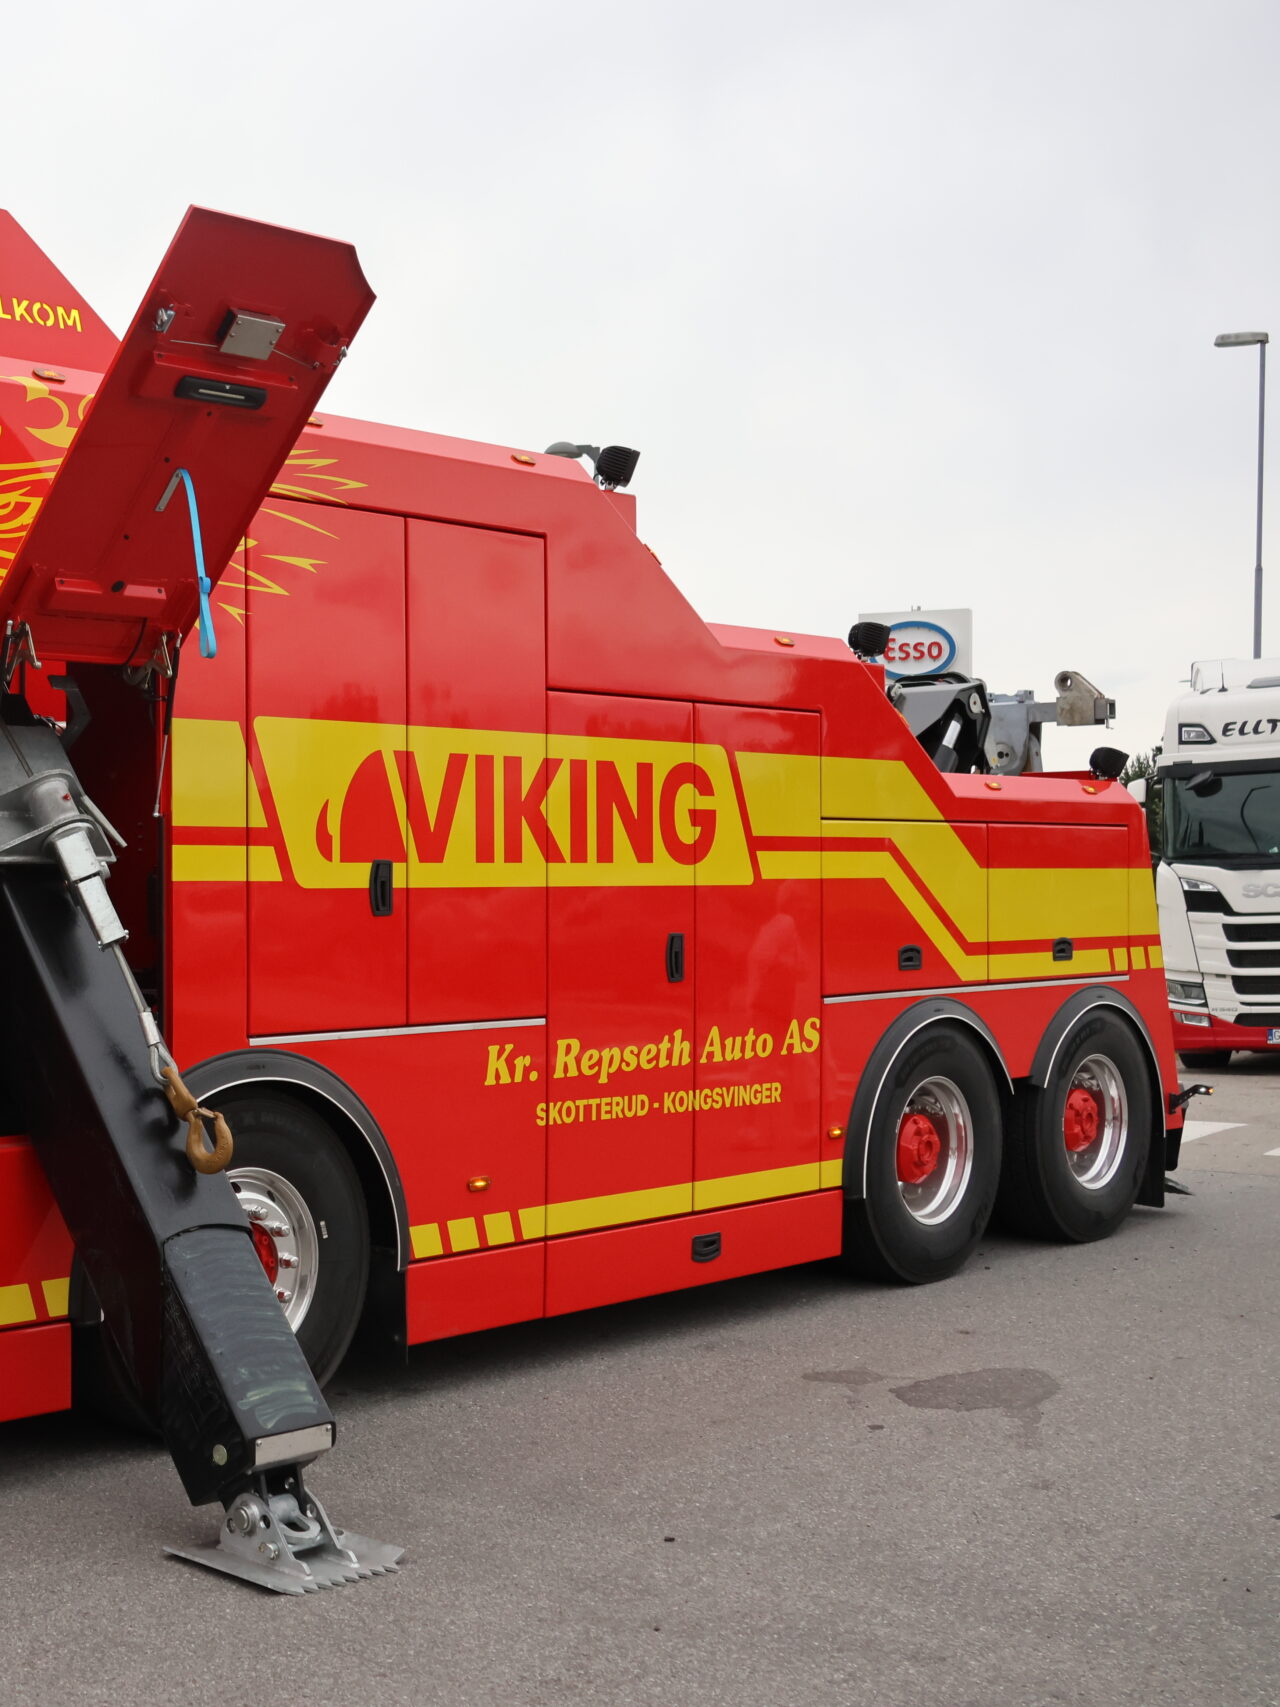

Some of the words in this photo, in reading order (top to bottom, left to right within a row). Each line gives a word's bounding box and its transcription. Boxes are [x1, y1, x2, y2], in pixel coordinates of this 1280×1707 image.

[392, 749, 717, 866] VIKING
[484, 1043, 539, 1086] Kr.
[553, 1029, 691, 1084] Repseth
[699, 1025, 774, 1064] Auto
[780, 1017, 821, 1056] AS
[536, 1094, 650, 1127] SKOTTERUD
[663, 1082, 782, 1114] KONGSVINGER
